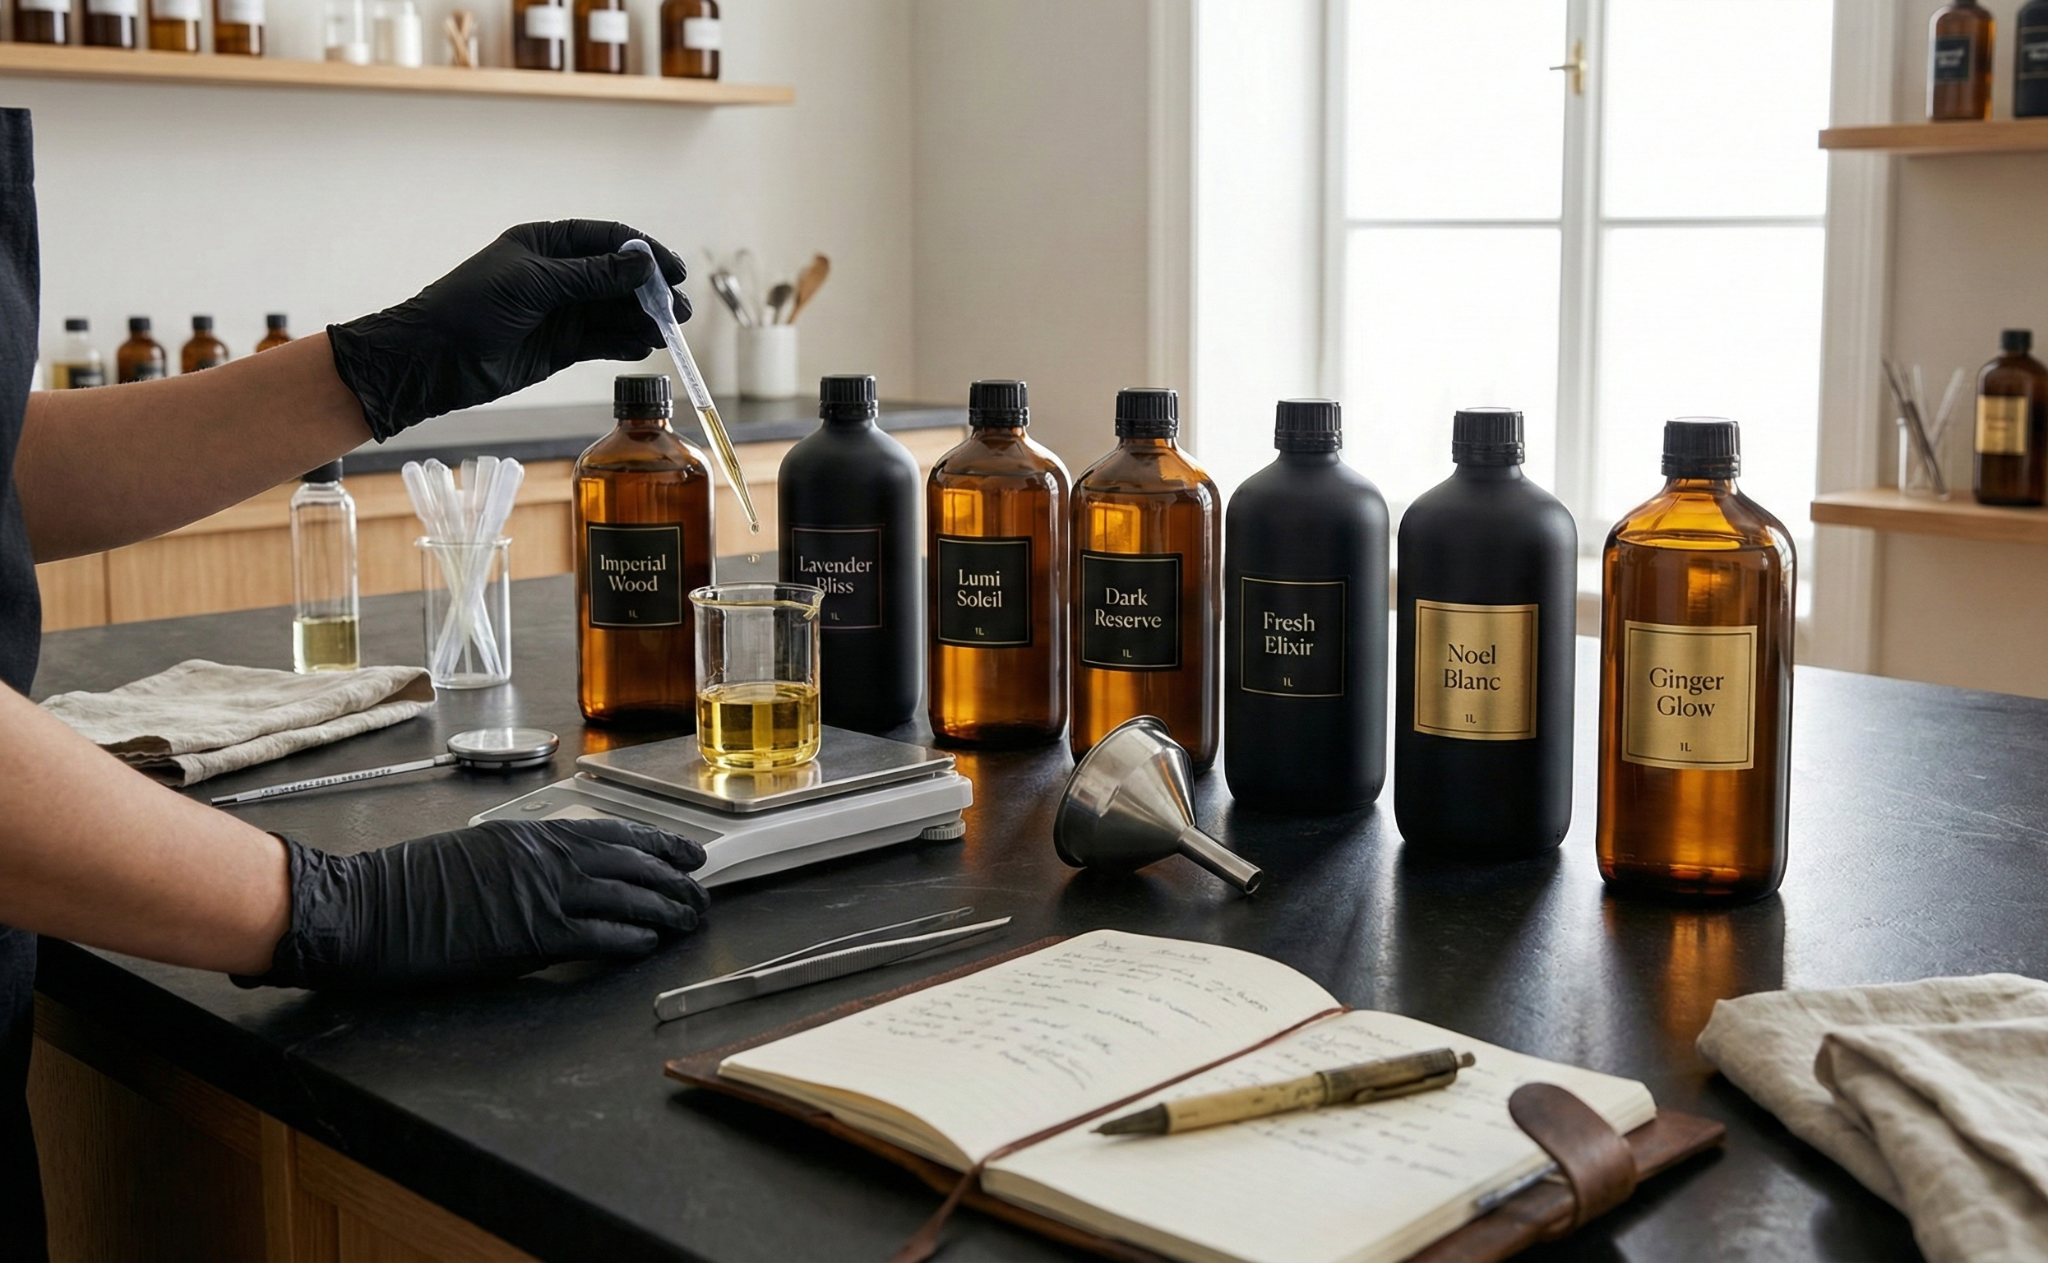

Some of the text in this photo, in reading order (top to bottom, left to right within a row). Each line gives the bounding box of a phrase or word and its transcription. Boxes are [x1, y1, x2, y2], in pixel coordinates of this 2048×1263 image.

[600, 553, 666, 574] Imperial
[800, 555, 873, 573] Lavender
[608, 574, 658, 592] Wood
[816, 576, 855, 594] Bliss
[958, 568, 1001, 587] Lumi
[957, 589, 1003, 608] Soleil
[1105, 587, 1148, 606] Dark
[628, 609, 639, 619] 1L
[830, 612, 840, 621] 1L
[1095, 608, 1162, 629] Reserve
[1263, 611, 1316, 632] Fresh
[974, 627, 985, 636] 1L
[1122, 649, 1133, 658] 1L
[1264, 635, 1314, 656] Elixir
[1448, 643, 1497, 665] Noel
[1283, 677, 1294, 687] 1L
[1443, 668, 1501, 691] Blanc
[1649, 667, 1725, 696] Ginger
[1656, 694, 1716, 718] Glow
[1465, 713, 1477, 724] 1L
[1680, 742, 1692, 752] 1L
